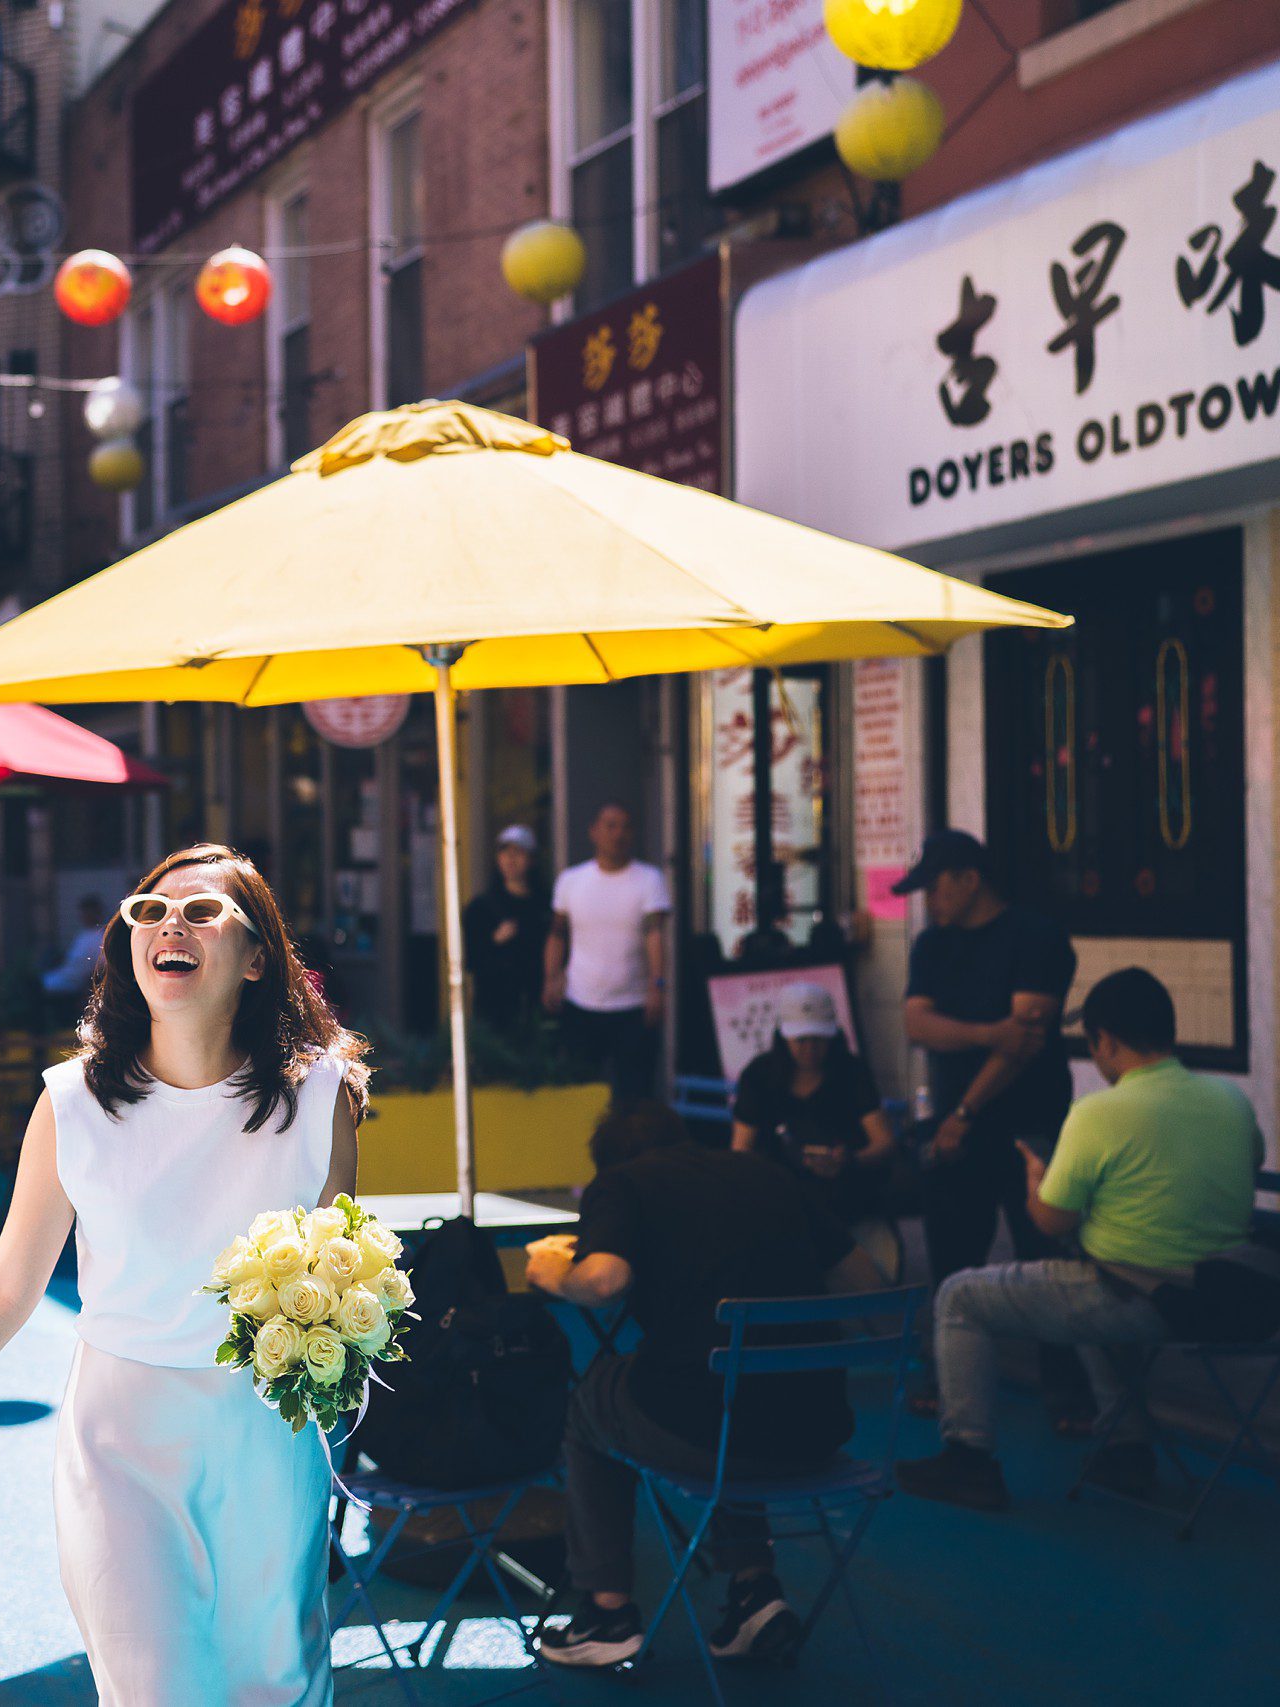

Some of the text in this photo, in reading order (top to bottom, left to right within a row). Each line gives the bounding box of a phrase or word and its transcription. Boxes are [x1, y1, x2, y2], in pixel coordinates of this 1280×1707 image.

[936, 159, 1280, 428] 古早味
[908, 432, 1055, 508] DOYERS
